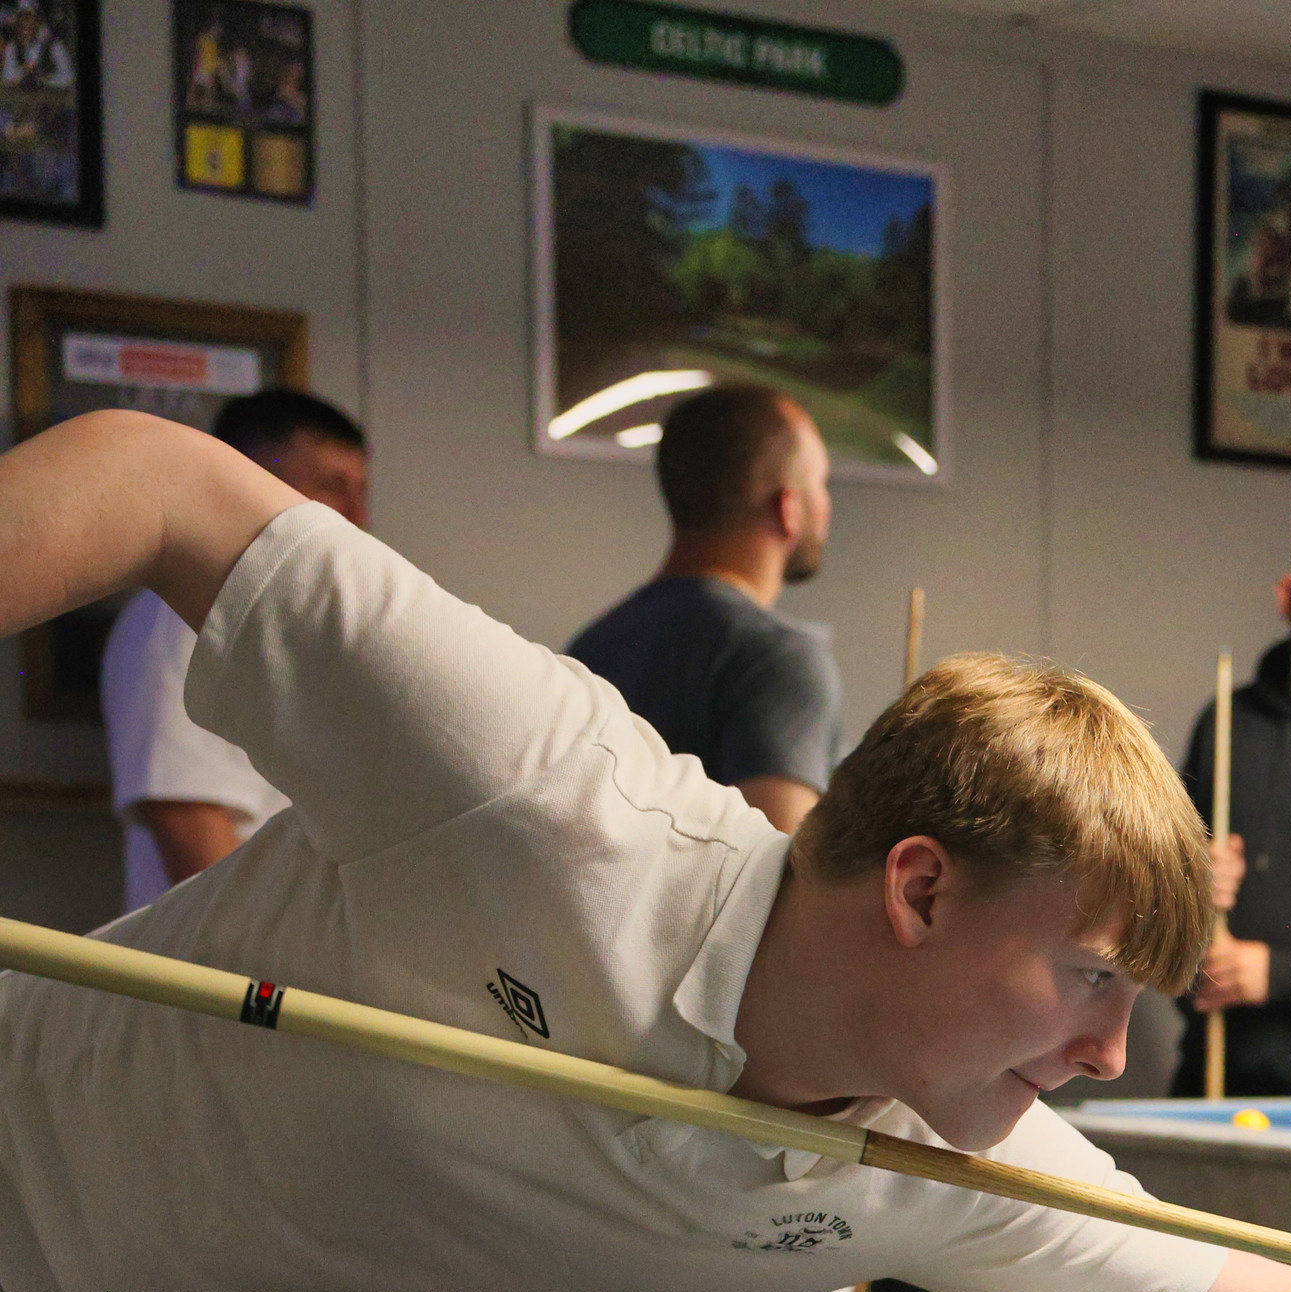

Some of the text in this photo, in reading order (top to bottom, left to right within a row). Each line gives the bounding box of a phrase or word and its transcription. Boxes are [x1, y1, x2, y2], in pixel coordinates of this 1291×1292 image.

[752, 36, 827, 79] PARK
[771, 1212, 853, 1241] LUTON TOWN
